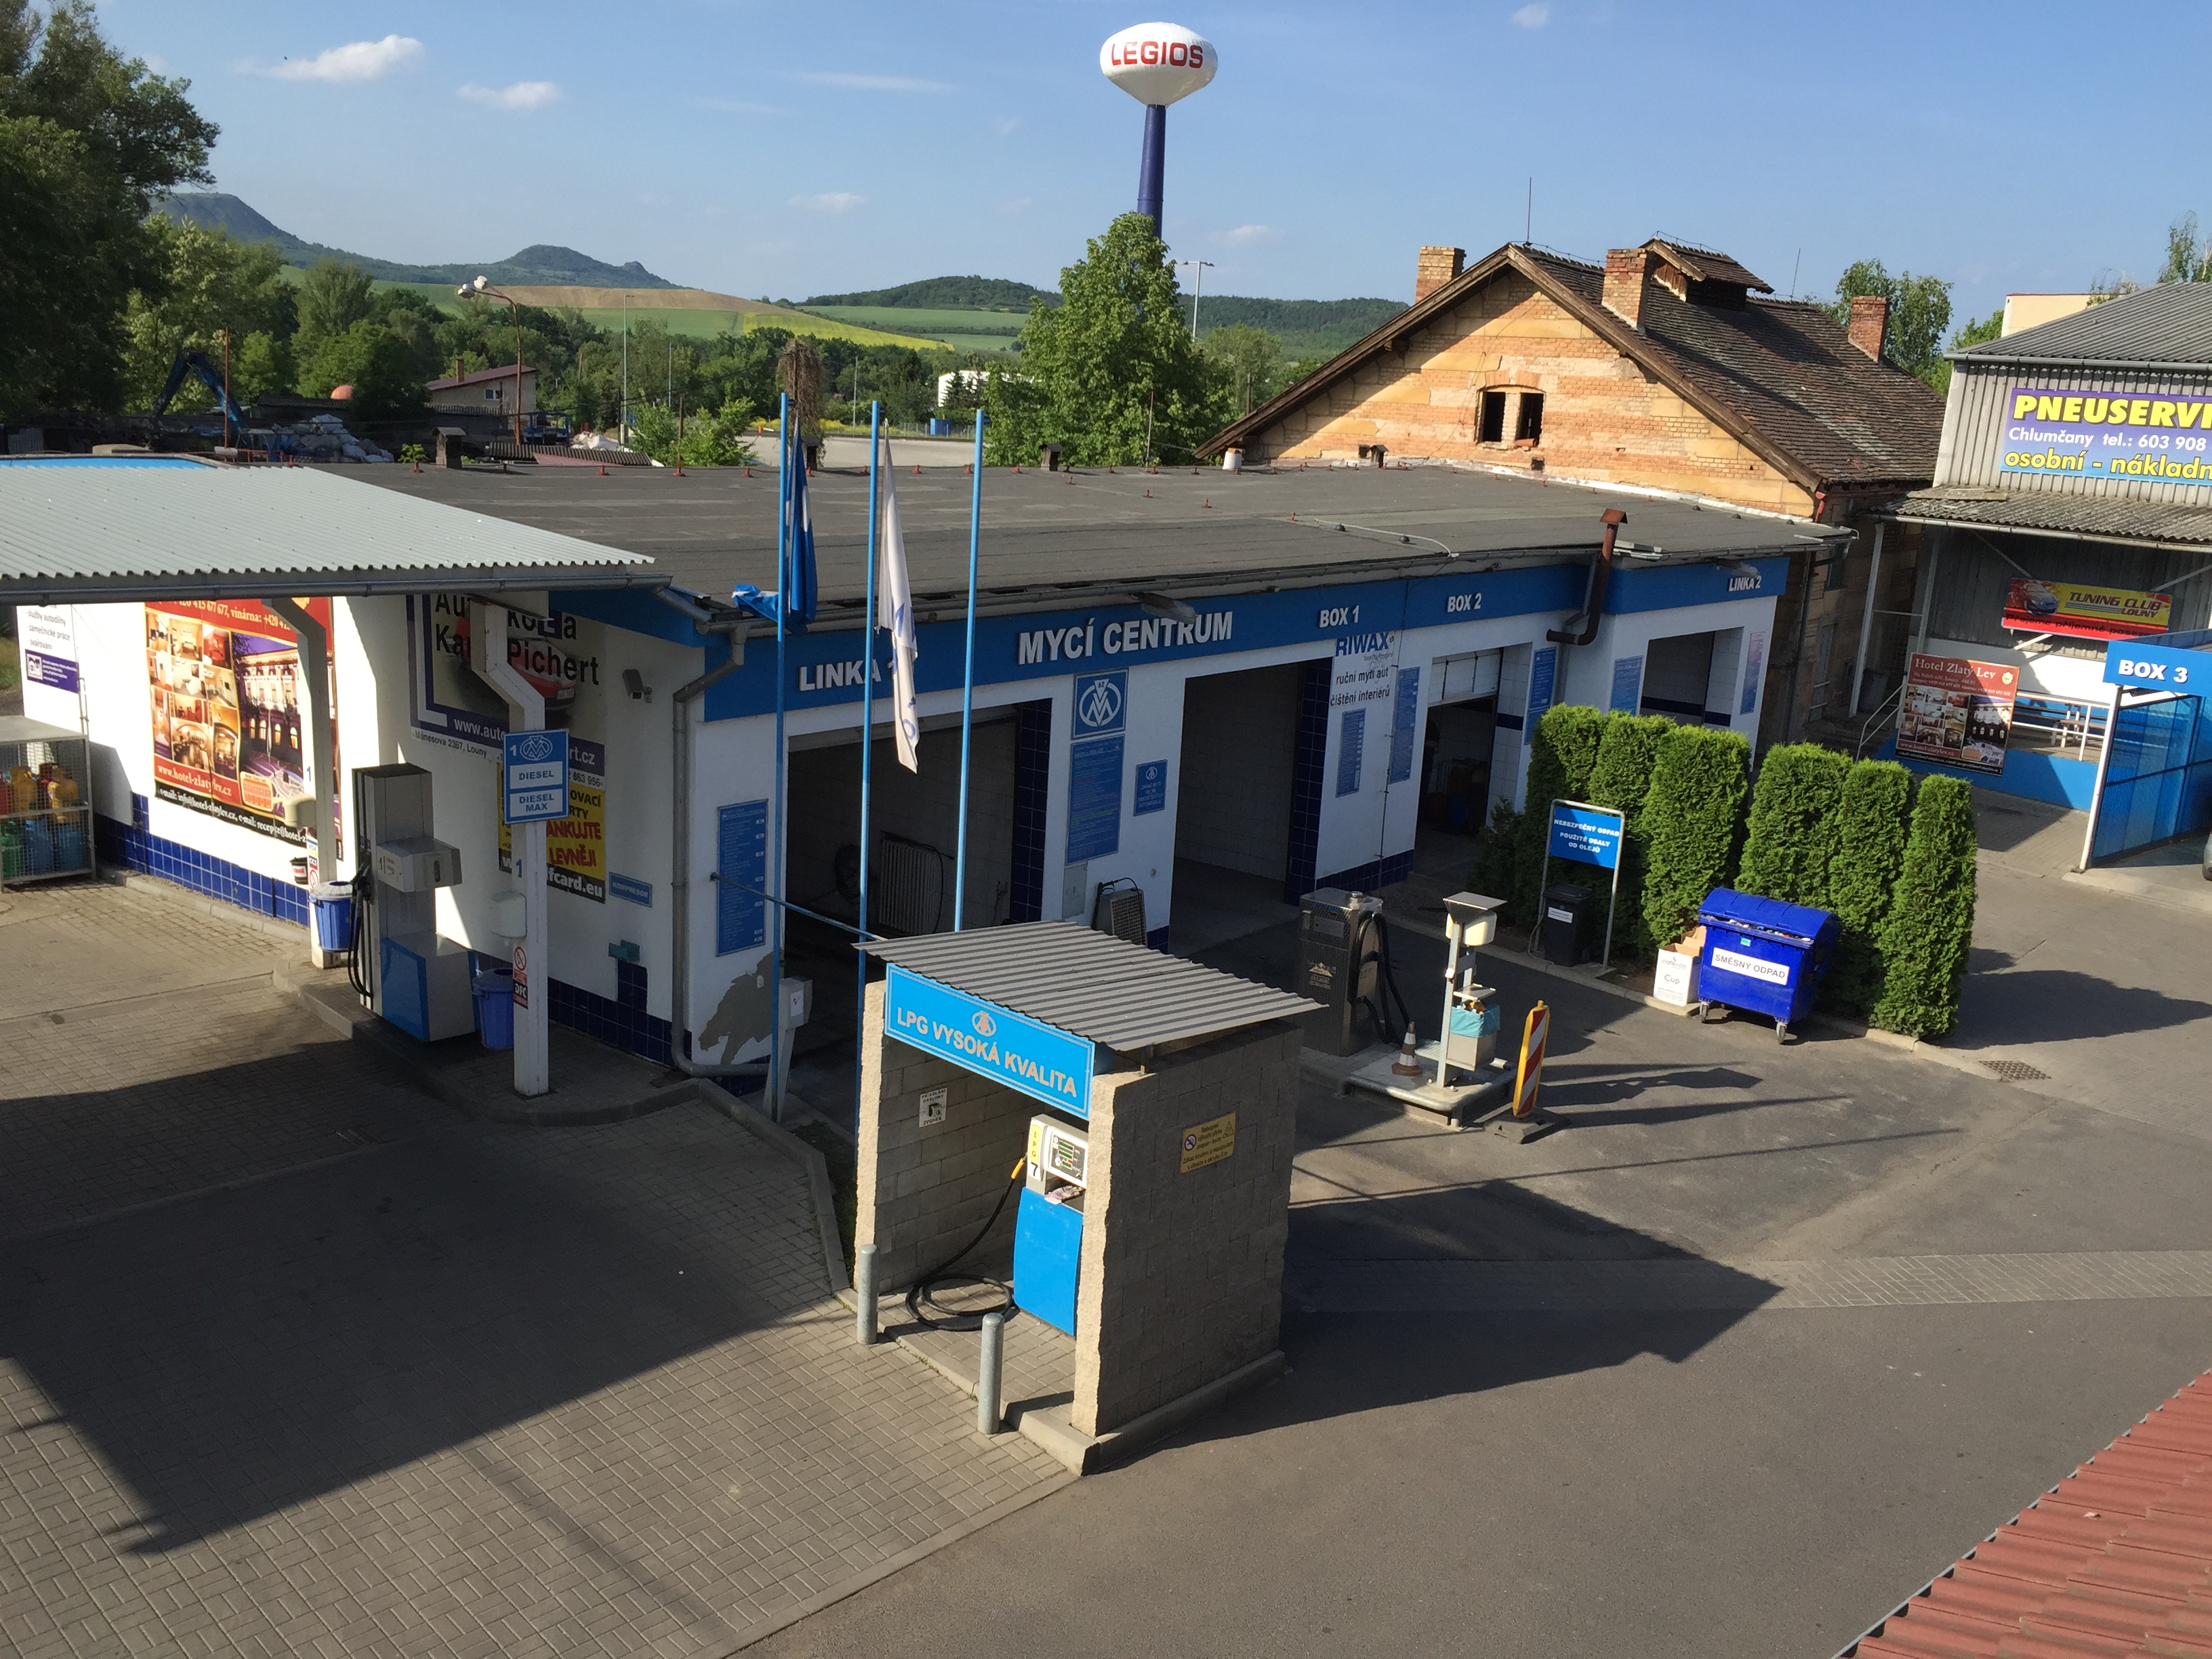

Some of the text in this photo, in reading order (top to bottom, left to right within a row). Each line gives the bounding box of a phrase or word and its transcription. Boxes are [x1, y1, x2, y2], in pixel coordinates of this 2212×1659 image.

[1111, 41, 1204, 68] LEGIOS
[2012, 394, 2212, 430] PNEUSERVI
[2009, 427, 2207, 451] Chlumčany tel.: 603 908
[2004, 447, 2089, 472] osobní
[1728, 575, 1762, 592] LINKA 2
[1447, 592, 1482, 613] BOX 2
[2069, 592, 2163, 611] TUNING CLUB
[230, 608, 262, 623] vinárna:
[1319, 605, 1359, 628] BOX 1
[2120, 608, 2158, 618] LOUNY
[1019, 611, 1233, 665] MYCÍ CENTRUM
[1336, 632, 1389, 657] RIWAX
[508, 639, 599, 686] Pichert
[1915, 658, 1996, 678] Hotel Zlatý Lev
[2118, 659, 2188, 684] BOX 3
[1336, 670, 1356, 685] ruční
[1376, 667, 1389, 678] aut
[1330, 684, 1390, 707] čištění interiérů
[415, 730, 447, 746] Mánesova
[467, 745, 487, 758] Louny
[510, 745, 517, 756] 1
[306, 766, 312, 782] 1
[519, 770, 554, 781] DIESEL
[573, 773, 586, 783] 863
[519, 794, 554, 804] DIESEL
[525, 803, 548, 812] MAX
[1554, 819, 1620, 837] NEBEZPEČNÝ ODPAD
[1559, 832, 1610, 847] POUŽITÉ OBALY
[1579, 844, 1601, 853] OLEJŮ
[549, 844, 597, 867] LEVNĚJI
[516, 859, 523, 878] 1
[612, 882, 649, 899] KOMPRESOR
[1715, 954, 1786, 979] SMĚSNÝ ODPAD
[1664, 974, 1680, 985] Cup
[897, 1007, 1077, 1098] LPG VYSOKÁ KVALITA
[1031, 1161, 1038, 1177] 7
